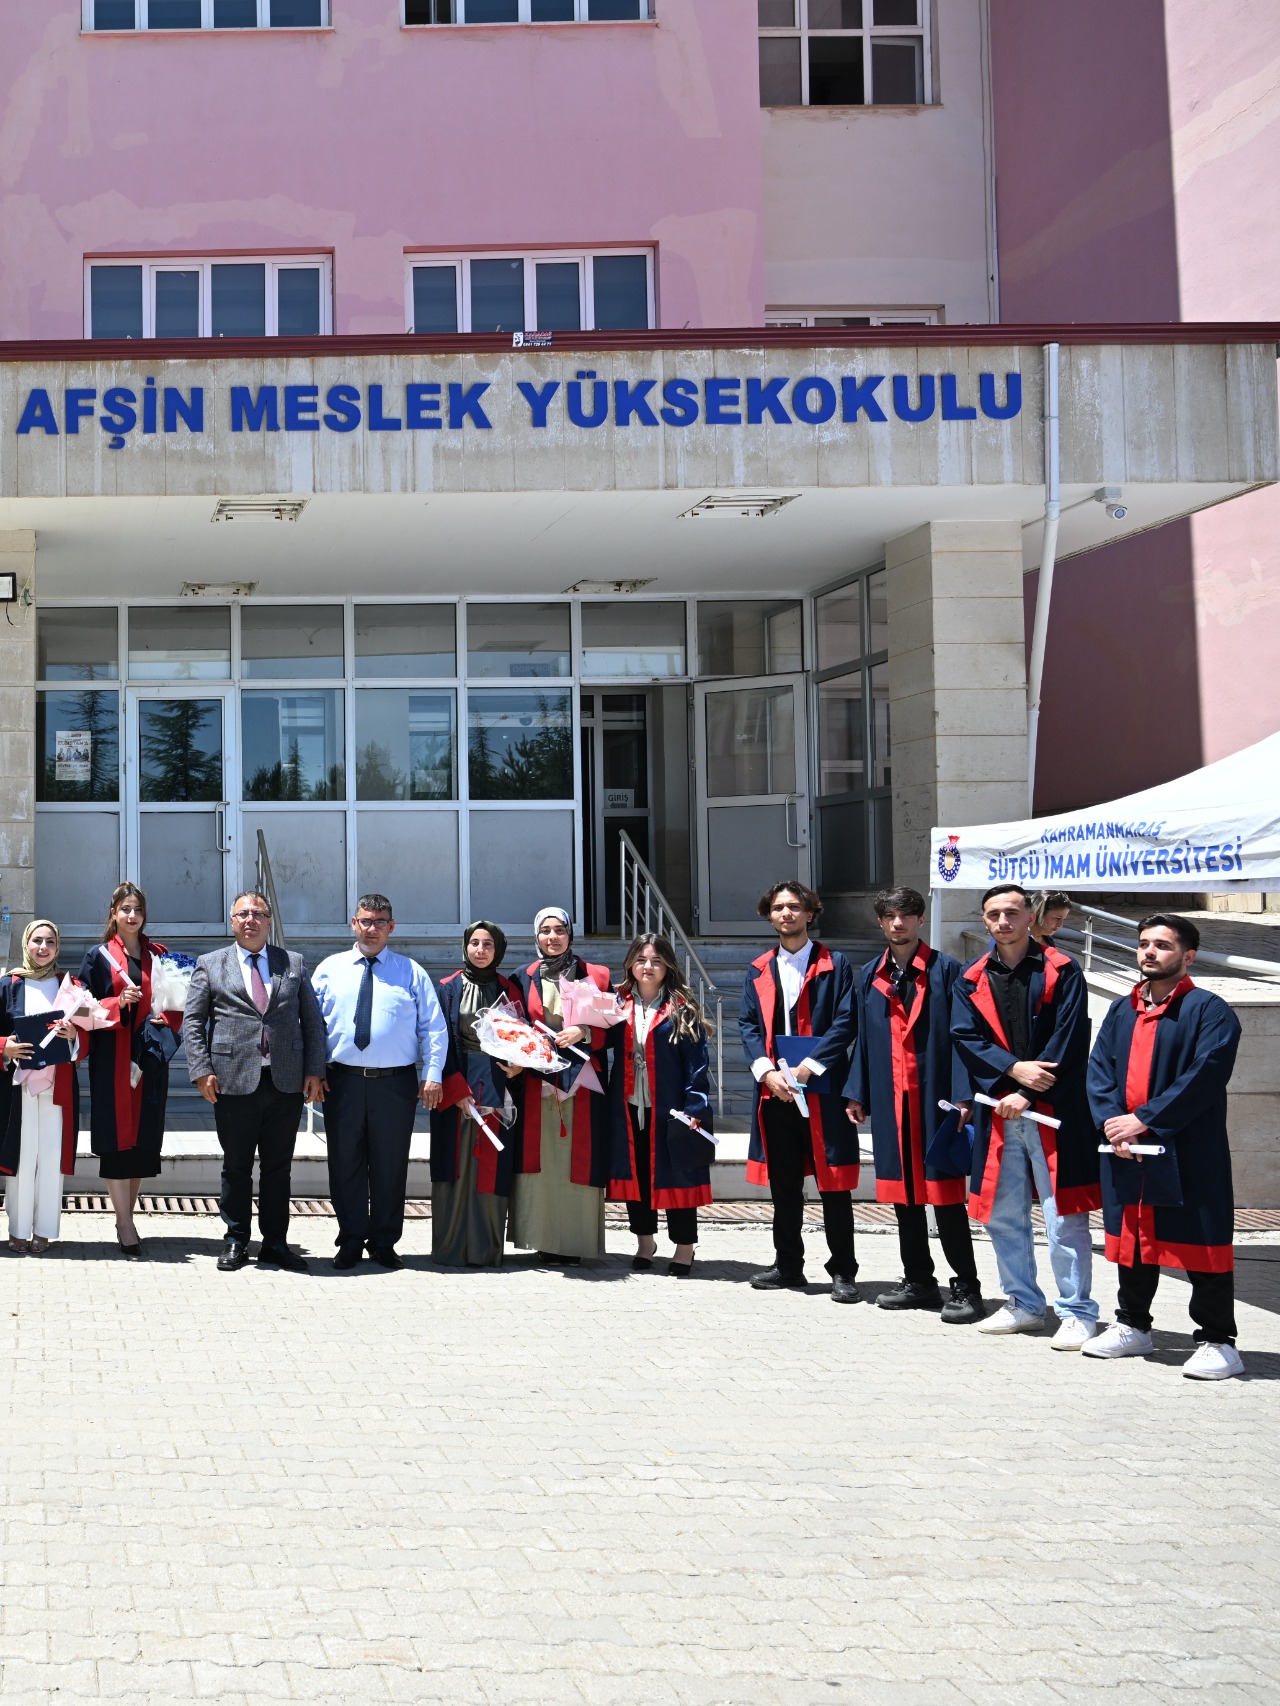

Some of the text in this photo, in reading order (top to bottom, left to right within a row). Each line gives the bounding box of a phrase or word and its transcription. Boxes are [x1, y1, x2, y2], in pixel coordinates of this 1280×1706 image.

[16, 370, 1023, 450] AFŞİN MESLEK YÜKSEKOKULU
[1040, 821, 1167, 843] KAHRAMANMARAŞ
[988, 836, 1243, 886] SÜTÇÜ İMAM ÜNİVERSİTESİ
